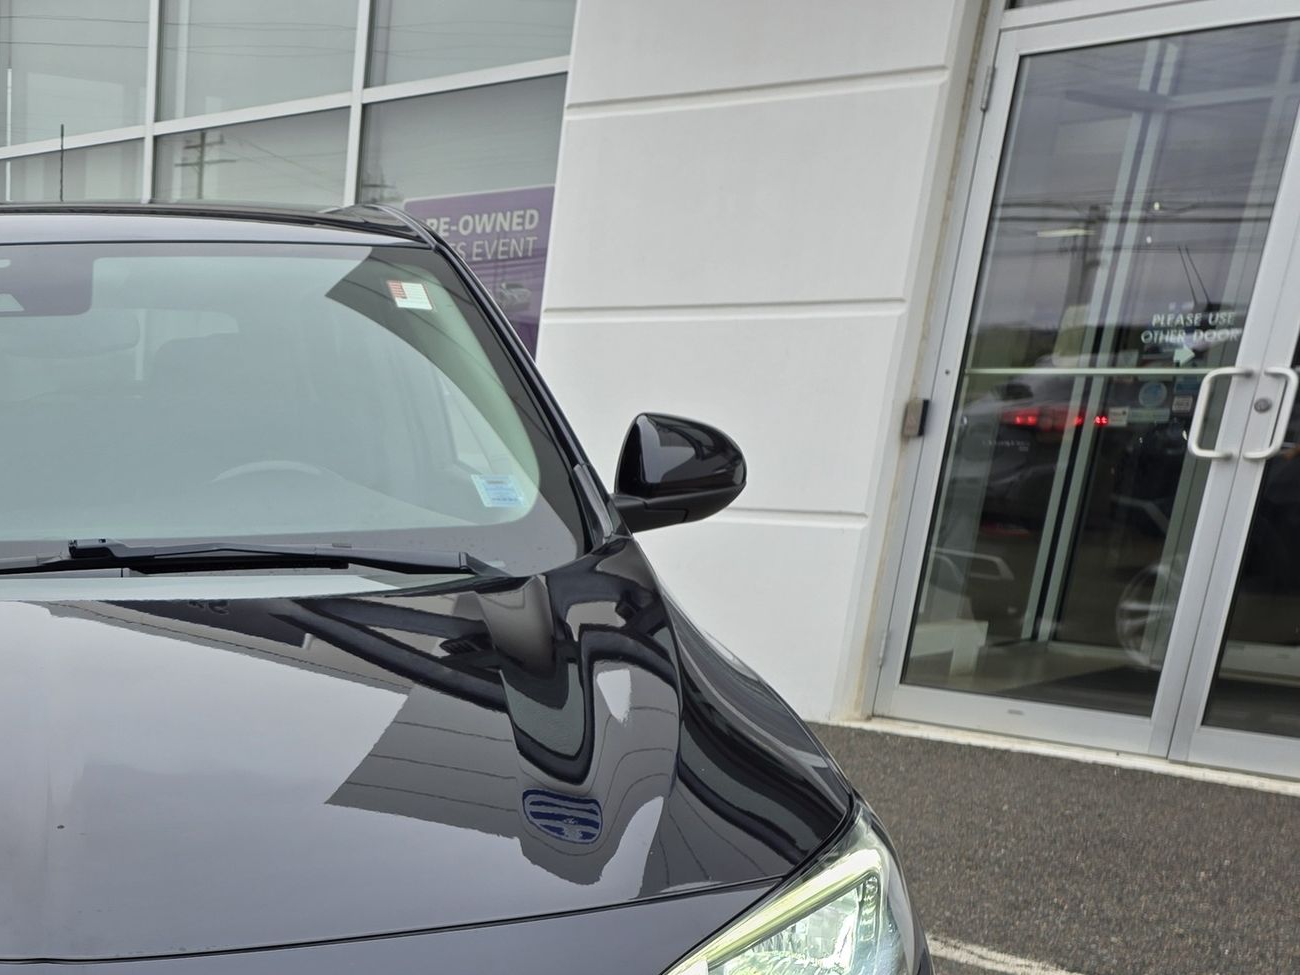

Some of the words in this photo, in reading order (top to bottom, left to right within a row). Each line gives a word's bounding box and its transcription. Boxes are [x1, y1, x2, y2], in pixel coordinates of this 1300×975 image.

[423, 209, 539, 236] RE-OWNED
[472, 236, 538, 261] EVENT
[1151, 313, 1202, 327] PLEASE
[1208, 311, 1236, 326] USE
[1140, 329, 1186, 344] OTHER
[1192, 328, 1243, 342] DOOR
